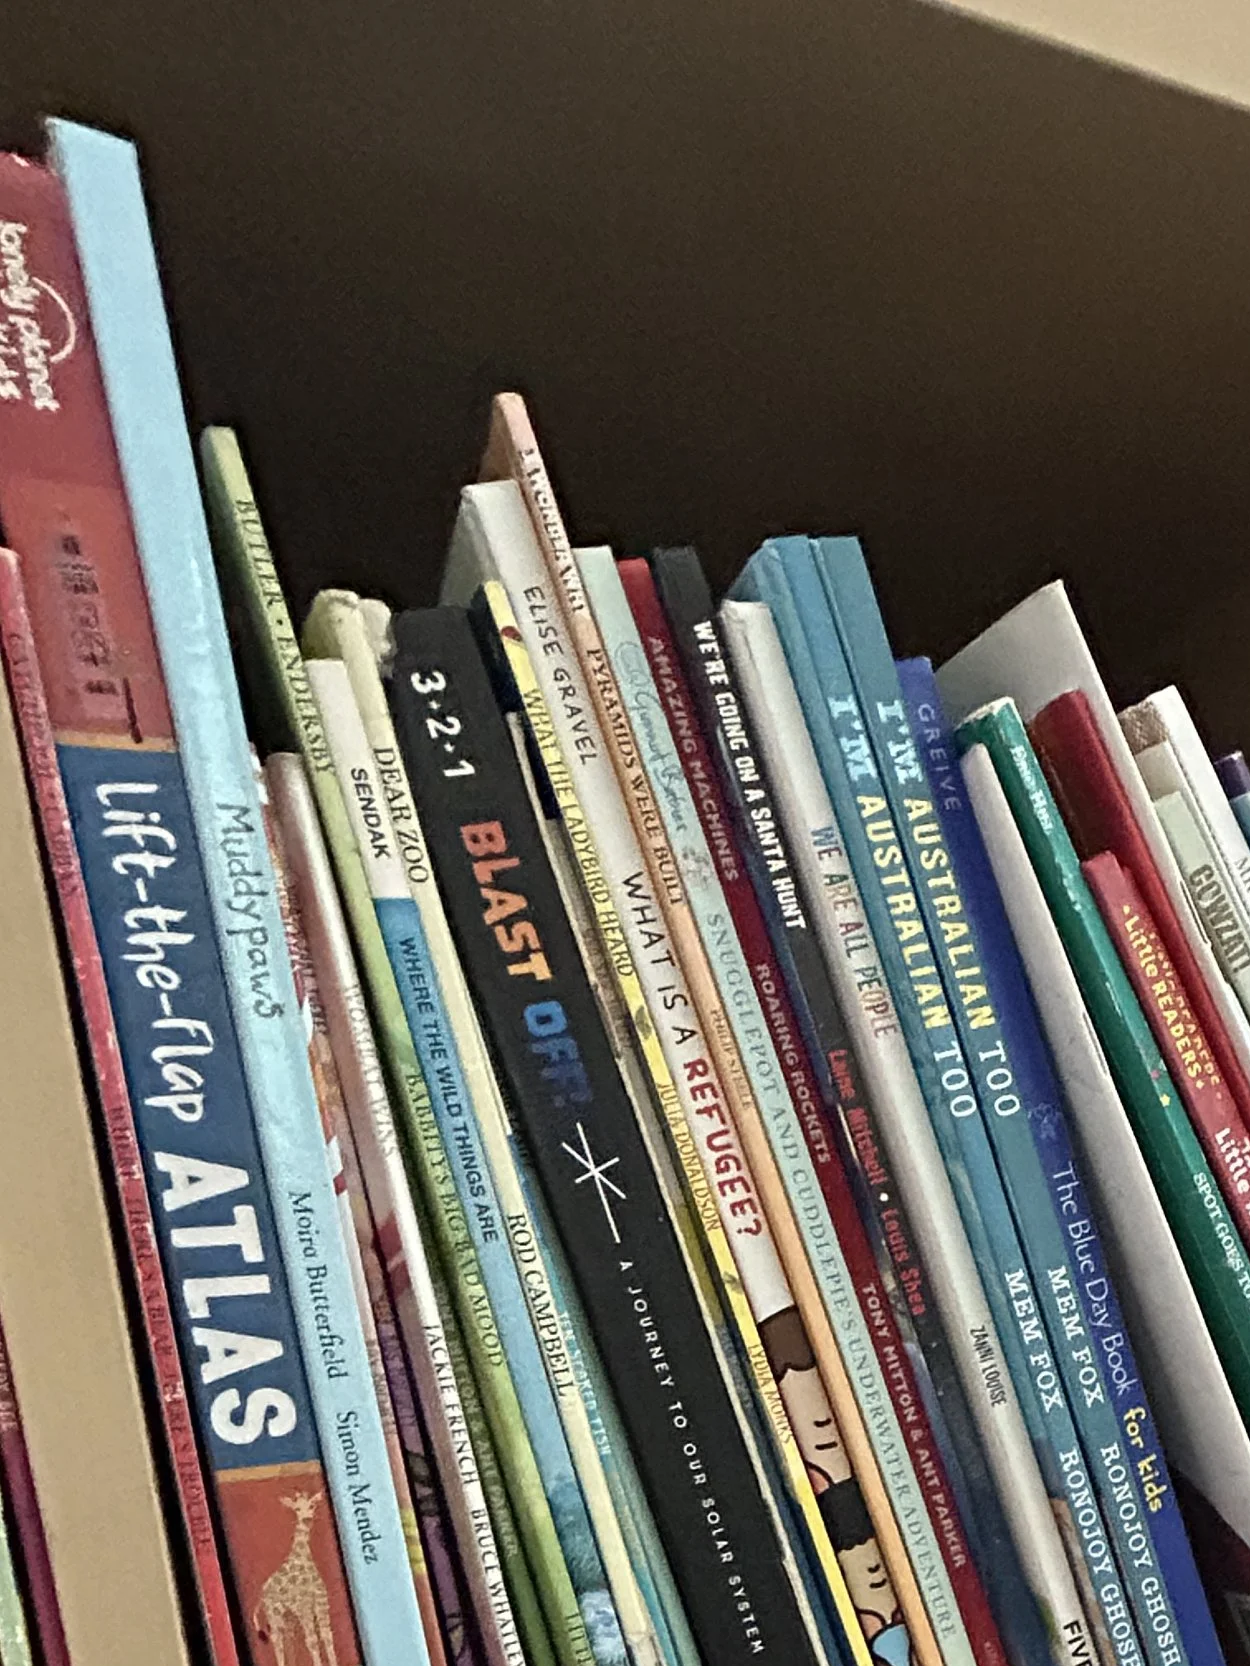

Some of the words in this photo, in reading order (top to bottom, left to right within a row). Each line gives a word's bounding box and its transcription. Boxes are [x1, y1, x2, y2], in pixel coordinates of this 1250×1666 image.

[235, 496, 284, 608] BUTLER
[277, 632, 335, 778] ENDERSBY
[523, 585, 563, 656] ELISE
[552, 666, 598, 765] GRAVEL
[692, 620, 730, 686] WE'RE
[519, 687, 558, 753] WHAT
[646, 635, 699, 755] AMAZING
[688, 759, 740, 882] MACHINES
[714, 691, 750, 752] GOING
[545, 758, 575, 799] THE
[585, 647, 642, 769] PYRAMIDS
[629, 773, 661, 840] WERE
[652, 844, 686, 906] BUILT
[733, 754, 760, 784] ON
[743, 787, 766, 804] A
[349, 767, 391, 860] SENDAK
[372, 747, 413, 824] DEAR
[396, 829, 430, 884] ZOO
[749, 806, 788, 874] SANTA
[810, 824, 843, 862] WE
[558, 801, 612, 907] LADYBIRD
[822, 873, 860, 911] ARE
[216, 803, 286, 1019] Muddypaws
[460, 821, 551, 981] BLAST
[622, 870, 677, 968] WHAT
[770, 875, 808, 930] HUNT
[827, 694, 879, 782] I'M
[857, 795, 958, 1029] AUSTRALIAN
[932, 1039, 982, 1119] TOO
[838, 920, 871, 960] ALL
[875, 699, 924, 786] I'M
[903, 798, 996, 1030] AUSTRALIAN
[977, 1039, 1022, 1118] TOO
[95, 781, 215, 1124] Lift-the-flap
[398, 937, 434, 1015] WHERE
[598, 908, 638, 980] HEARD
[657, 983, 689, 1012] IS
[670, 1022, 698, 1046] A
[853, 964, 903, 1038] PEOPLE
[1123, 914, 1164, 978] Little
[1150, 979, 1207, 1079] READERS
[421, 1019, 448, 1061] THE
[754, 962, 800, 1067] ROARING
[789, 1070, 832, 1164] ROCKETS
[434, 1064, 464, 1119] WILD
[451, 1121, 487, 1199] THINGS
[683, 1058, 769, 1236] REFUGEE?
[287, 1190, 321, 1259] Moira
[473, 1202, 500, 1244] ARE
[506, 1212, 538, 1265] ROD
[1192, 1171, 1224, 1220] SPOT
[1214, 1221, 1246, 1273] GOES
[153, 1151, 299, 1447] ATLAS
[706, 912, 782, 1095] SNUGGLEPOT
[771, 1106, 801, 1161] AND
[791, 1167, 858, 1332] CUDDLEPIE'S
[847, 1337, 912, 1499] UNDERWATER
[902, 1506, 957, 1637] ADVENTURE
[861, 1282, 892, 1338] TONY
[305, 1263, 349, 1380] Butterfield
[520, 1269, 575, 1398] CAMPBELL
[968, 1324, 996, 1364] ZANNI
[1051, 1161, 1081, 1216] The
[1066, 1218, 1096, 1274] Blue
[1084, 1277, 1114, 1329] Day
[1100, 1332, 1139, 1397] Book
[1122, 1405, 1148, 1450] for
[1136, 1453, 1169, 1514] kids
[881, 1344, 919, 1423] MITTON
[980, 1363, 1008, 1408] LOUISE
[1003, 1267, 1044, 1345] MEM
[1028, 1350, 1065, 1414] FOX
[1058, 1448, 1117, 1575] RONOJOY
[1046, 1265, 1086, 1341] MEM
[1070, 1345, 1106, 1408] FOX
[1099, 1442, 1154, 1568] RONOJOY
[335, 1409, 361, 1477] Simon
[424, 1321, 459, 1395] JACKIE
[444, 1400, 480, 1486] FRENCH
[470, 1506, 502, 1575] BRUCE
[618, 1258, 633, 1272] A
[626, 1285, 674, 1387] JOURNEY
[667, 1400, 689, 1430] TO
[682, 1441, 708, 1485] OUR
[700, 1497, 735, 1564] SOLAR
[727, 1574, 765, 1655] SYSTEM
[909, 1427, 925, 1443] &
[914, 1447, 941, 1488] ANT
[347, 1482, 383, 1566] Mendez
[930, 1492, 967, 1569] PARKER
